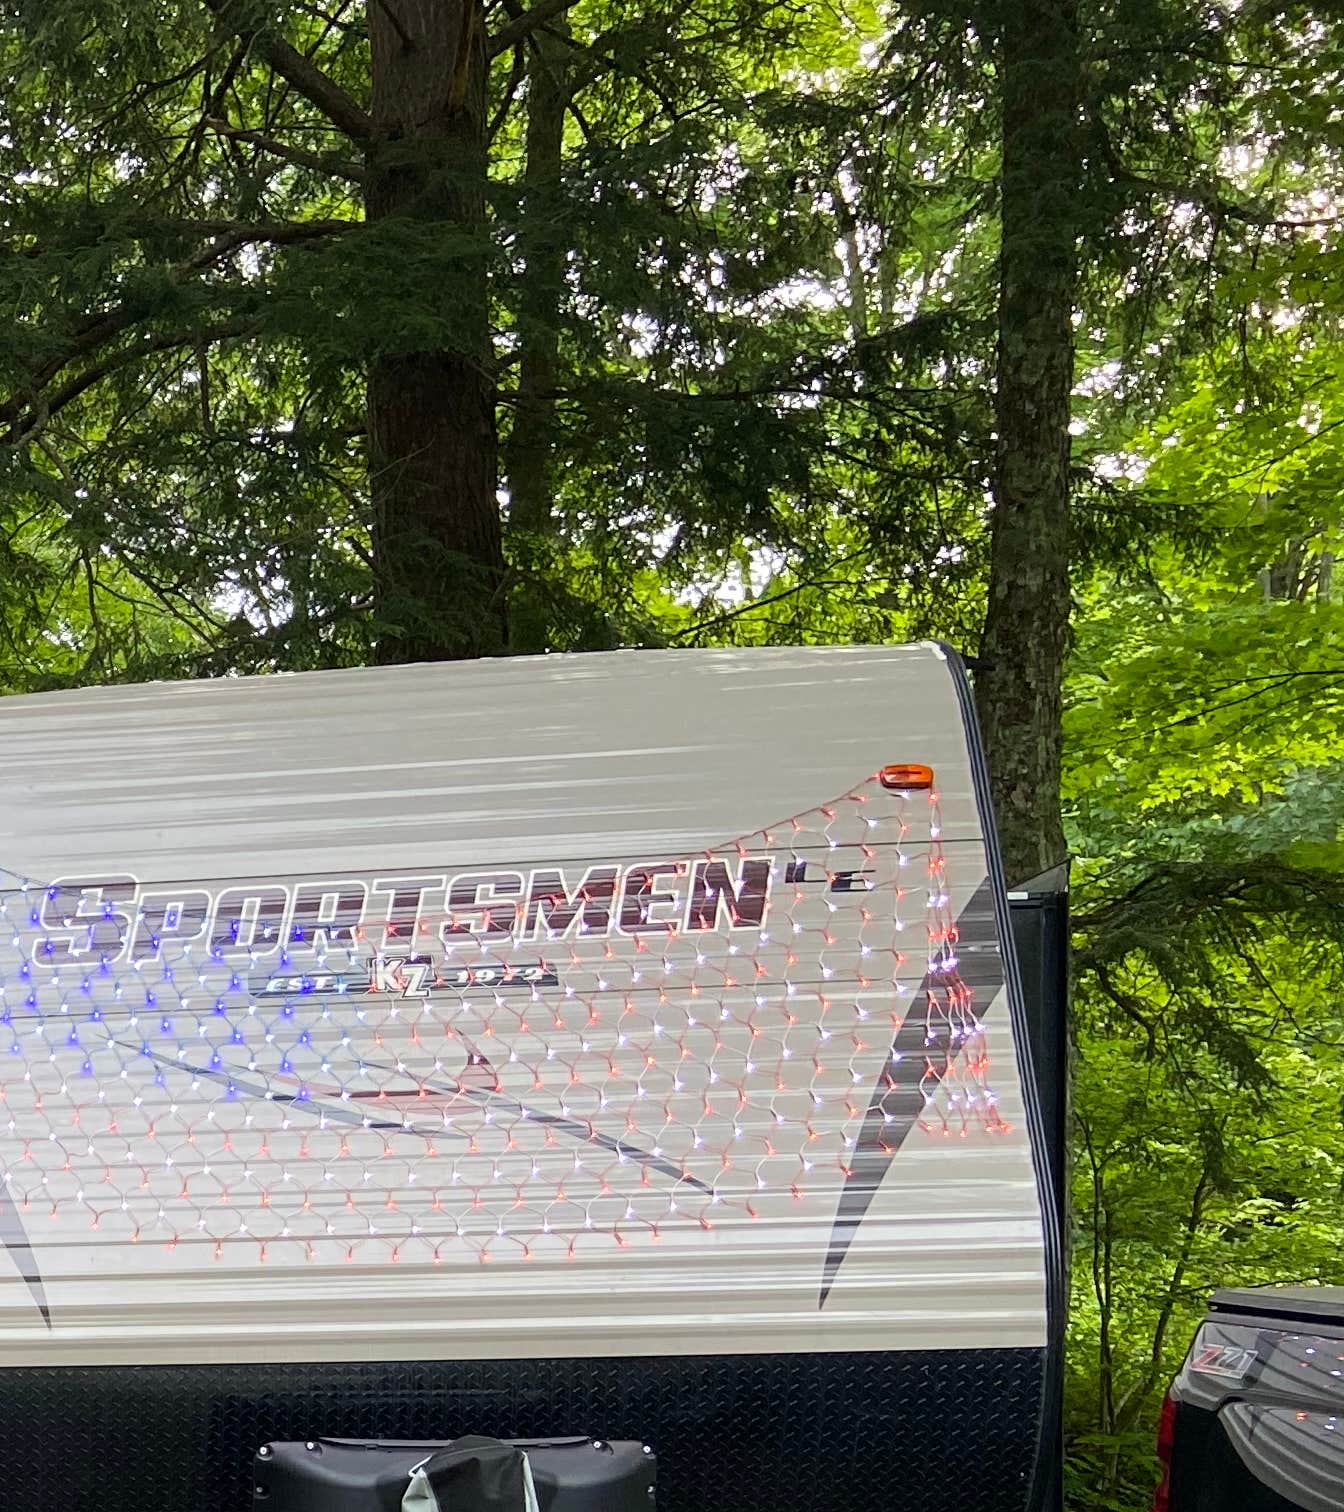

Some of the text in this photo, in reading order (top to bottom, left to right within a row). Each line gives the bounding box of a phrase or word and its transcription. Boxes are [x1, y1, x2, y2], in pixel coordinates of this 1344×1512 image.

[31, 855, 776, 968] SPORTSMEN
[374, 956, 431, 998] KZ
[1190, 1343, 1259, 1379] Z71
